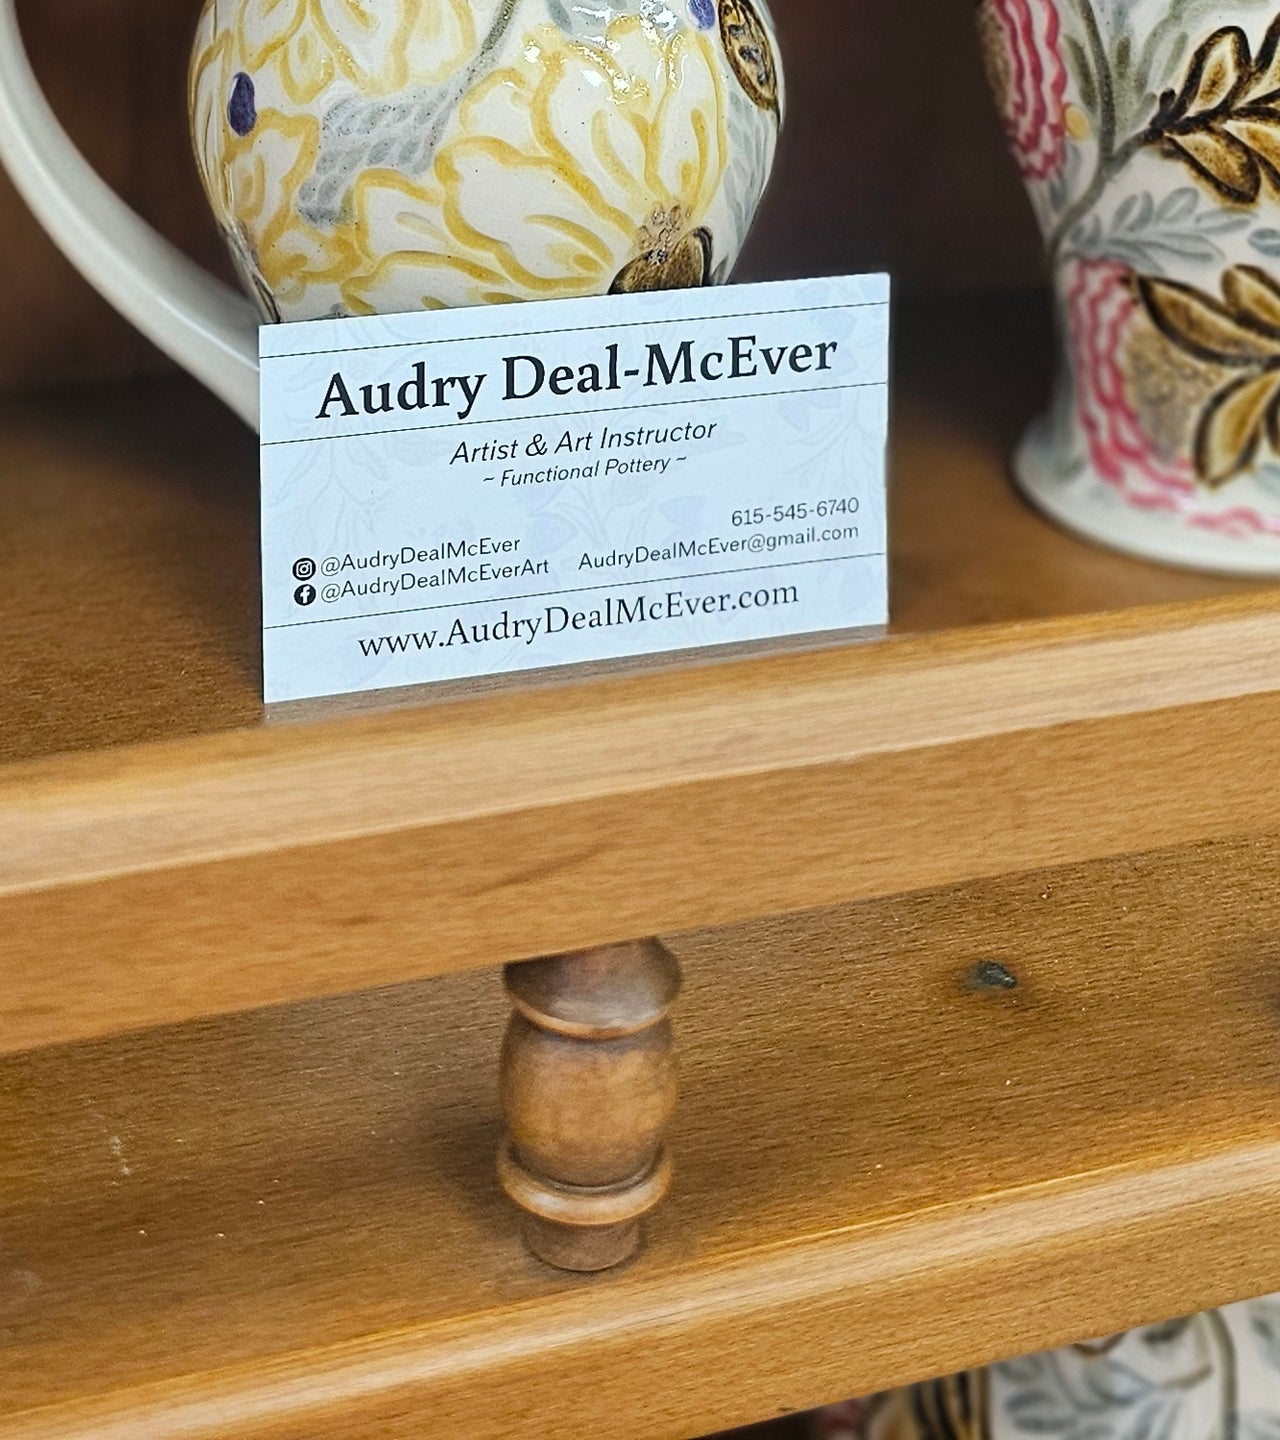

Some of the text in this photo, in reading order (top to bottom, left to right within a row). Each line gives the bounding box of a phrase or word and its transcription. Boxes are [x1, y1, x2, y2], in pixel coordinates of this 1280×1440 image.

[316, 335, 838, 419] Audry Deal-McEver
[450, 421, 717, 464] Artist & Art Instructor
[500, 461, 599, 487] Functional
[605, 455, 671, 477] Pottery
[731, 497, 859, 526] 615-545-6740
[321, 537, 520, 576] @AudryDealMcEver
[578, 526, 859, 570] AudryDealMcEver@gmail.com
[321, 558, 550, 603] @AudryDealMcEverArt
[358, 584, 799, 657] www.AudryDealMcEver.com
